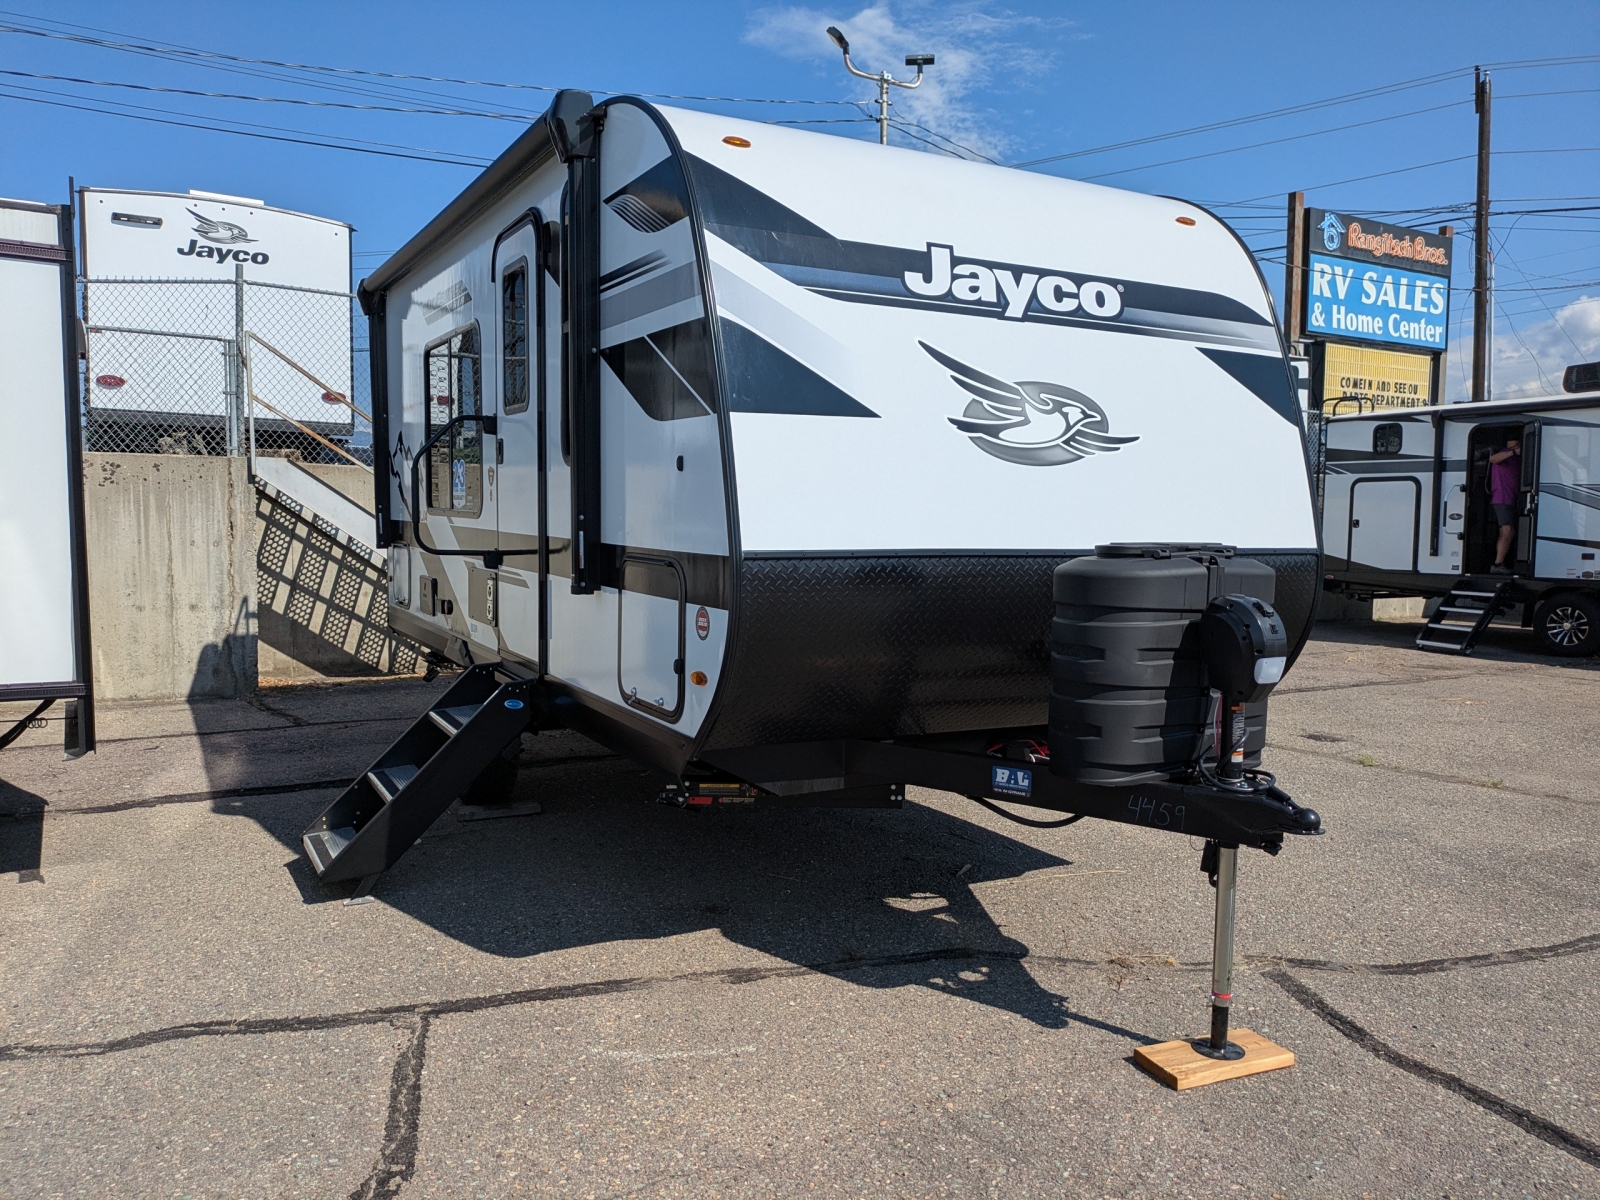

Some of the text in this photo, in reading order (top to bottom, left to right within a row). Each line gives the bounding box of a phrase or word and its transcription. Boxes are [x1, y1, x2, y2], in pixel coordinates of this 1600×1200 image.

[177, 238, 270, 265] Jayco
[1347, 222, 1448, 265] Rangitsch Bros.
[903, 244, 1122, 319] Jayco
[1312, 262, 1445, 315] RV SALES
[1311, 302, 1443, 343] & Home Center
[1376, 381, 1391, 392] AND
[1394, 382, 1407, 394] SEE
[1127, 794, 1186, 831] 4459
